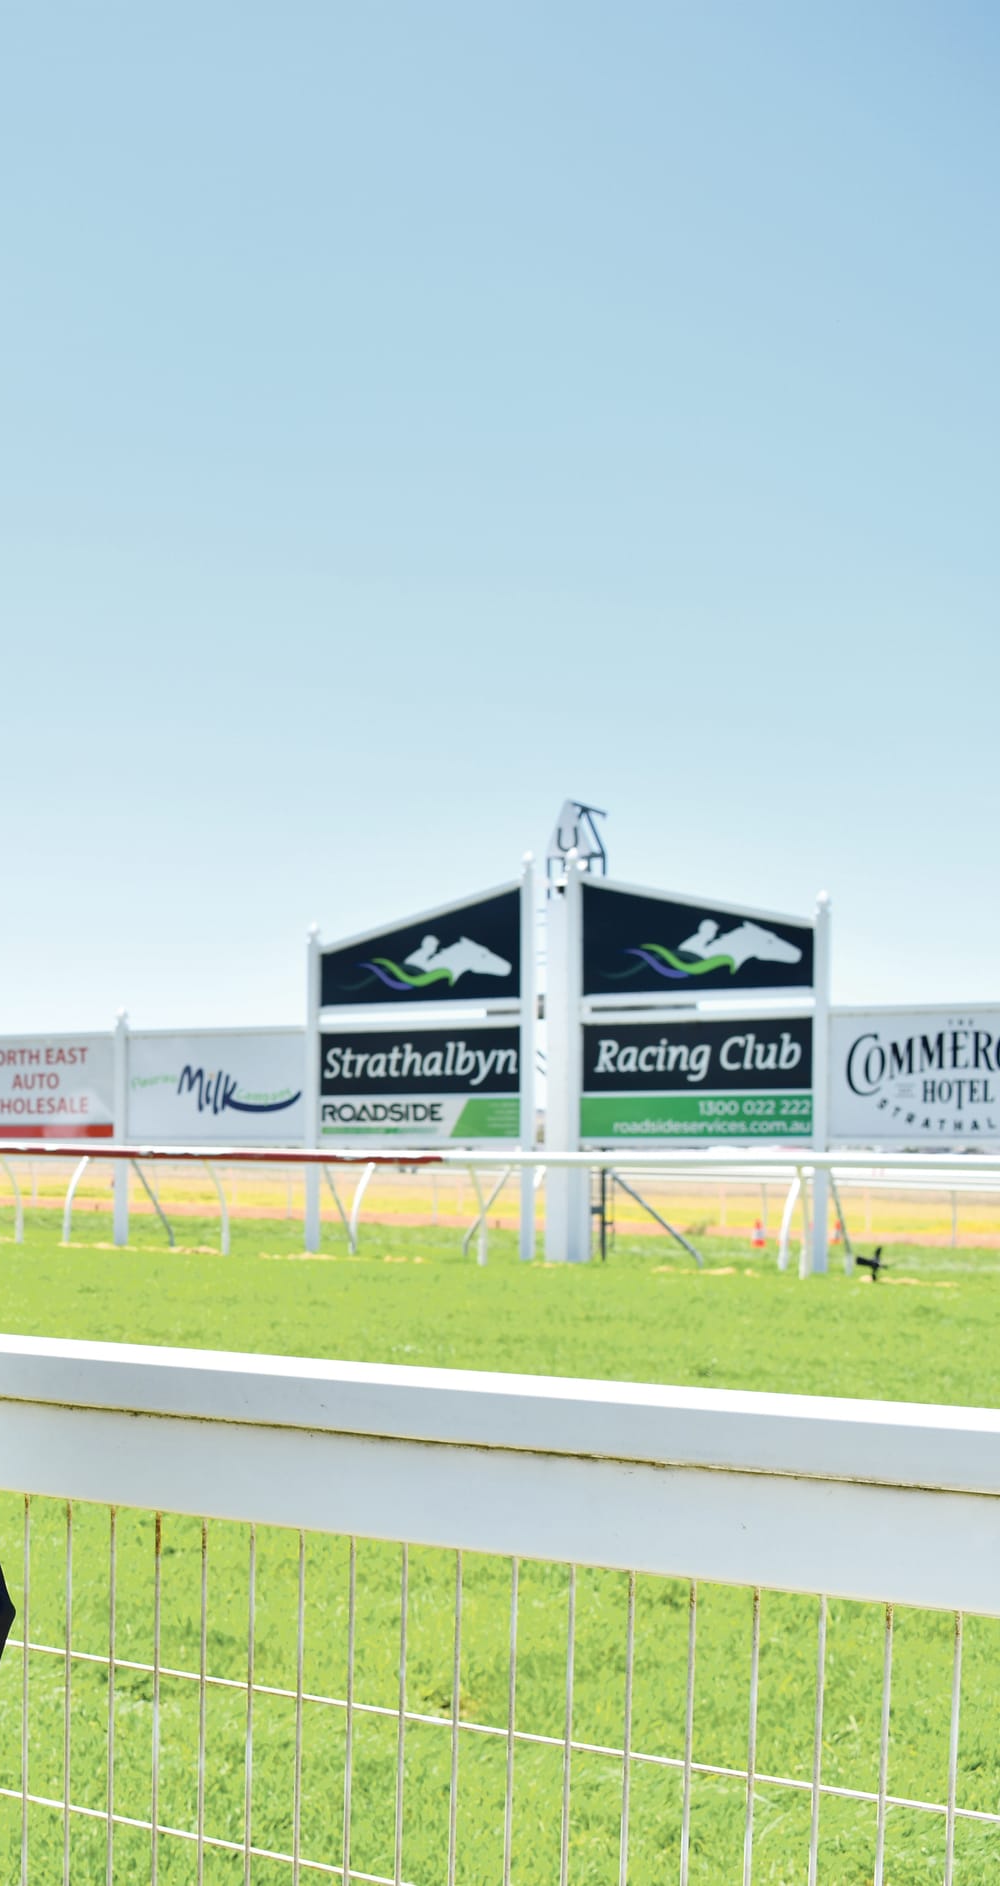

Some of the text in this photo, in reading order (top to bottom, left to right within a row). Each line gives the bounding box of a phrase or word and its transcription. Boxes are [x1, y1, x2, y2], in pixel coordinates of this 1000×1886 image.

[45, 1047, 88, 1065] EAST
[323, 1041, 518, 1086] Strathalbyn
[594, 1033, 802, 1082] Racing Club
[846, 1030, 1000, 1097] COMMER
[12, 1073, 60, 1090] AUTO
[177, 1064, 238, 1115] Milk
[698, 1099, 811, 1115] 1300 022 222
[922, 1079, 995, 1110] HOTEL
[321, 1103, 443, 1122] ROADSIDE
[612, 1118, 812, 1134] roadsideservices.com.au
